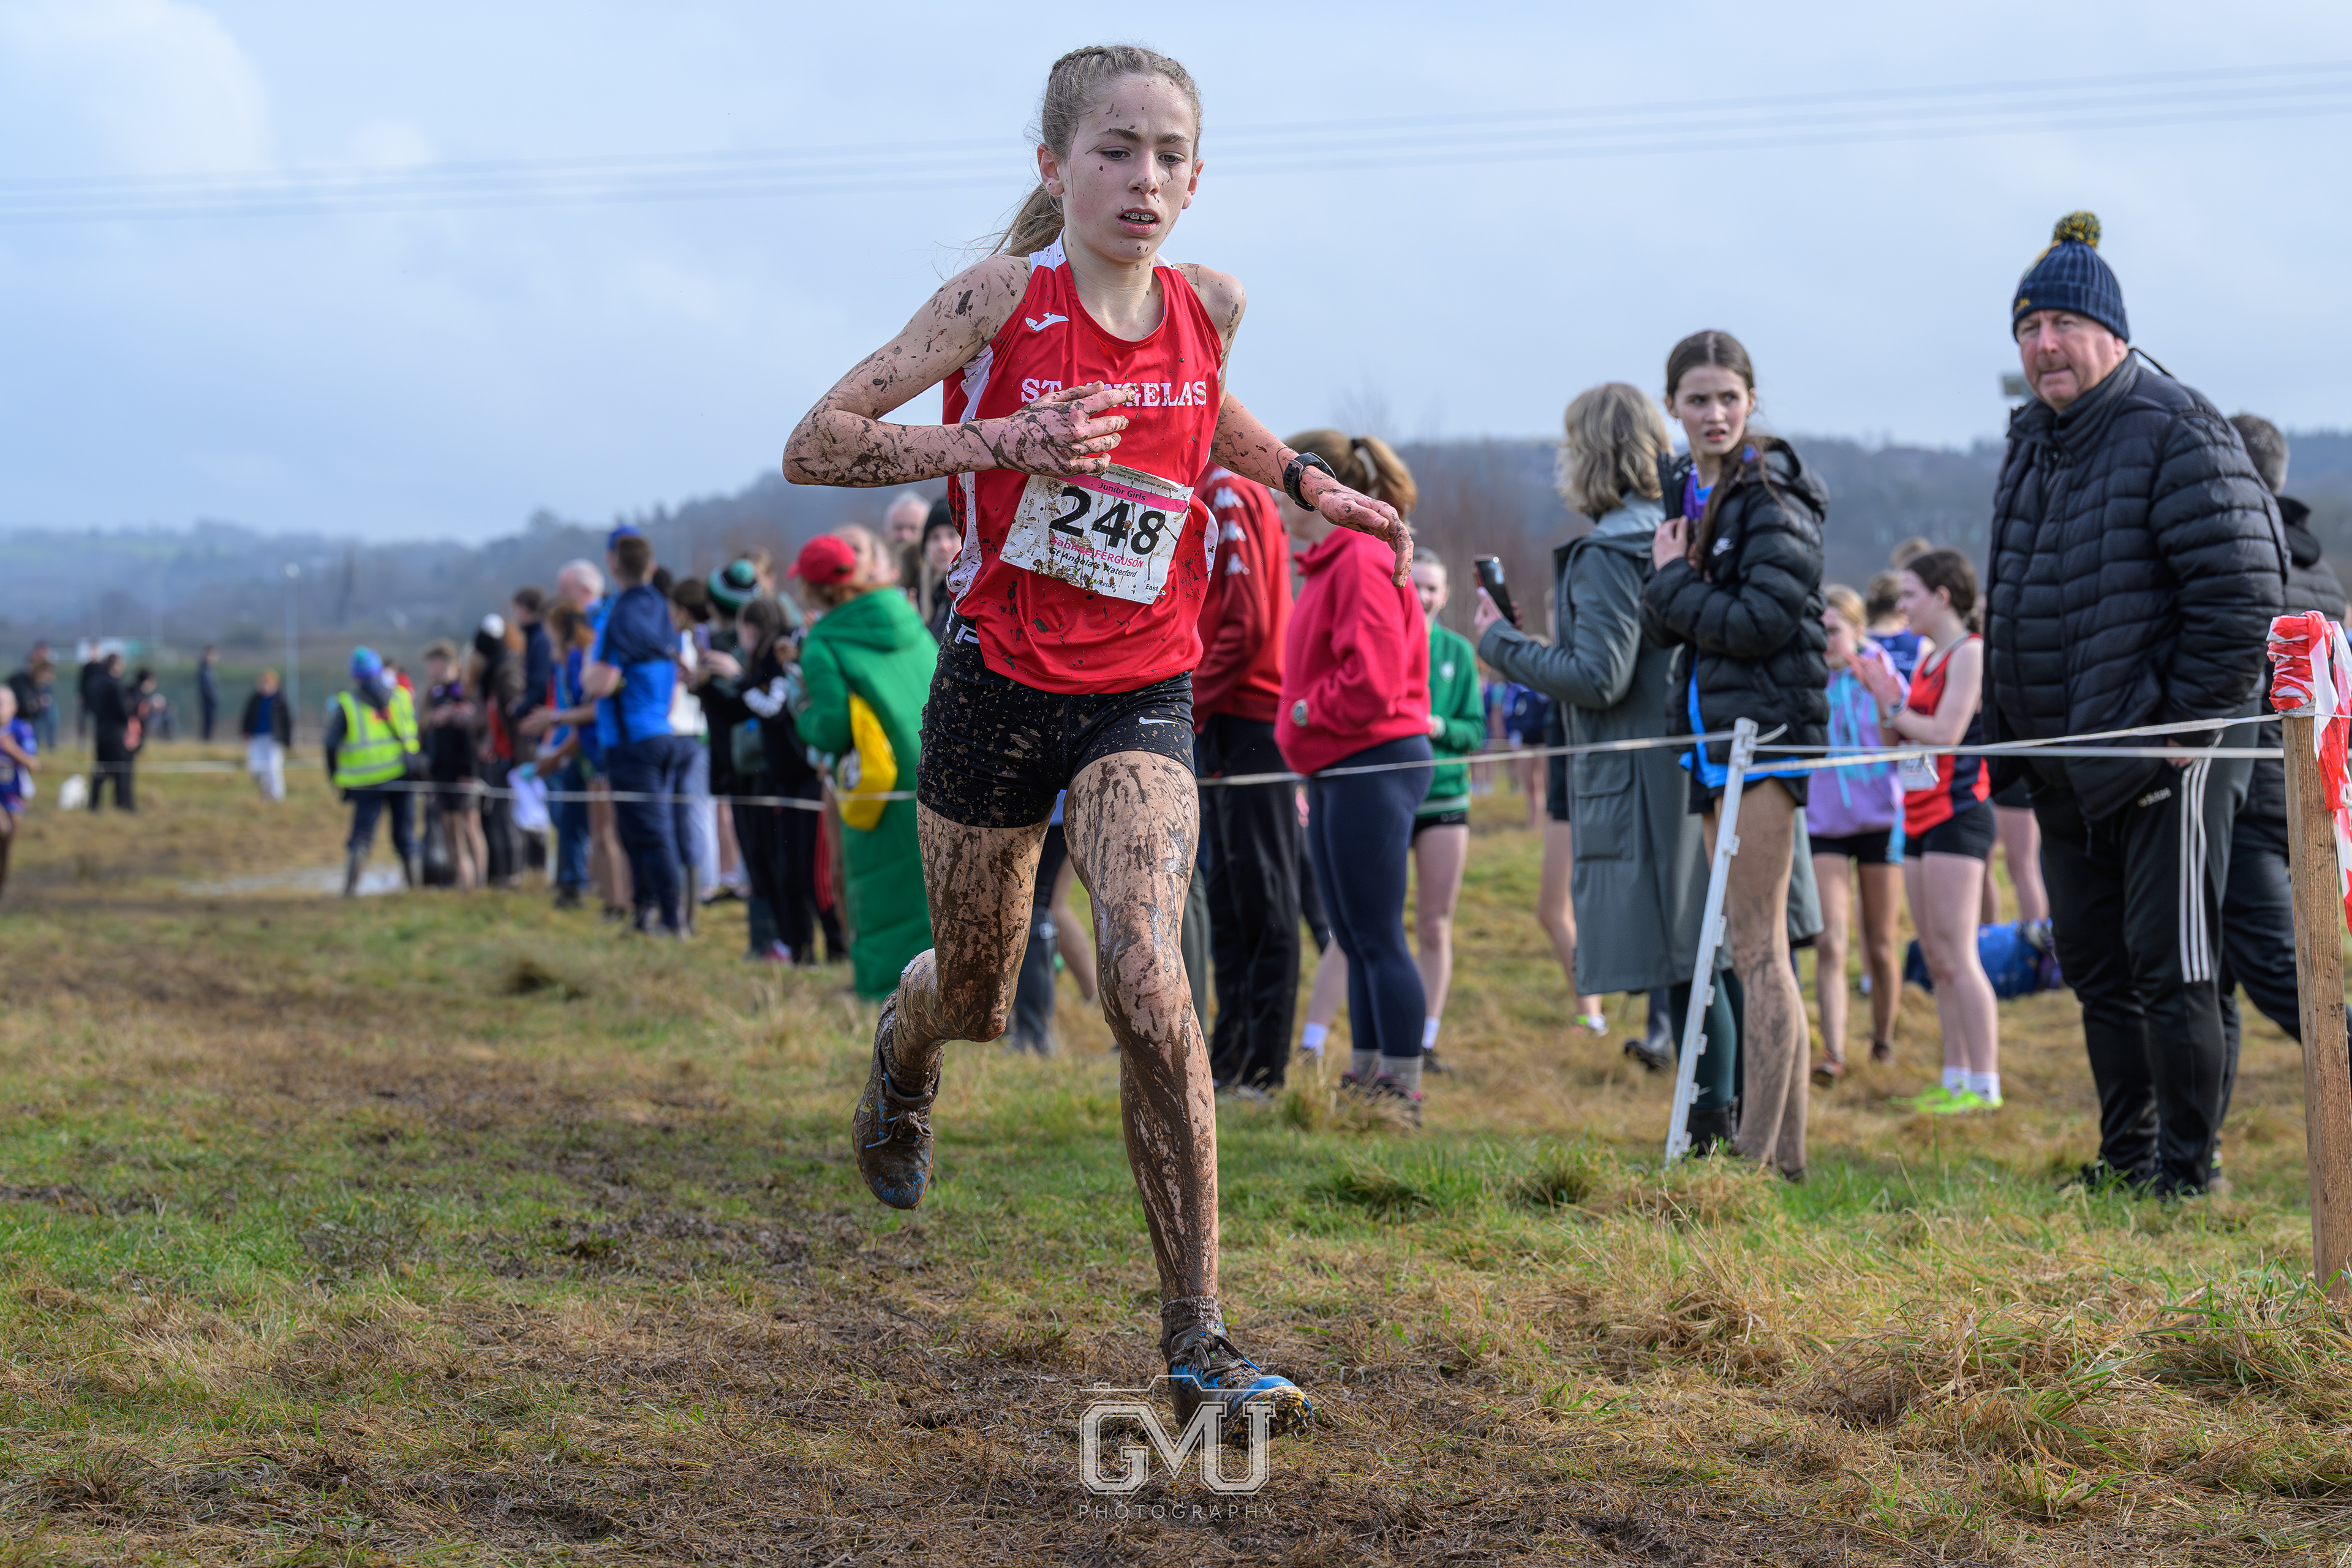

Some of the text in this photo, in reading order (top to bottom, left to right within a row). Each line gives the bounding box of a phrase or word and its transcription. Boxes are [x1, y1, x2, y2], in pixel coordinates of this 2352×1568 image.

[1086, 380, 1207, 407] GELAS
[1098, 482, 1146, 501] Junior Girls
[1049, 488, 1166, 555] 248
[1050, 536, 1144, 568] Saoirse FERGUSON
[1050, 548, 1061, 557] St
[1104, 565, 1137, 577] Waterford
